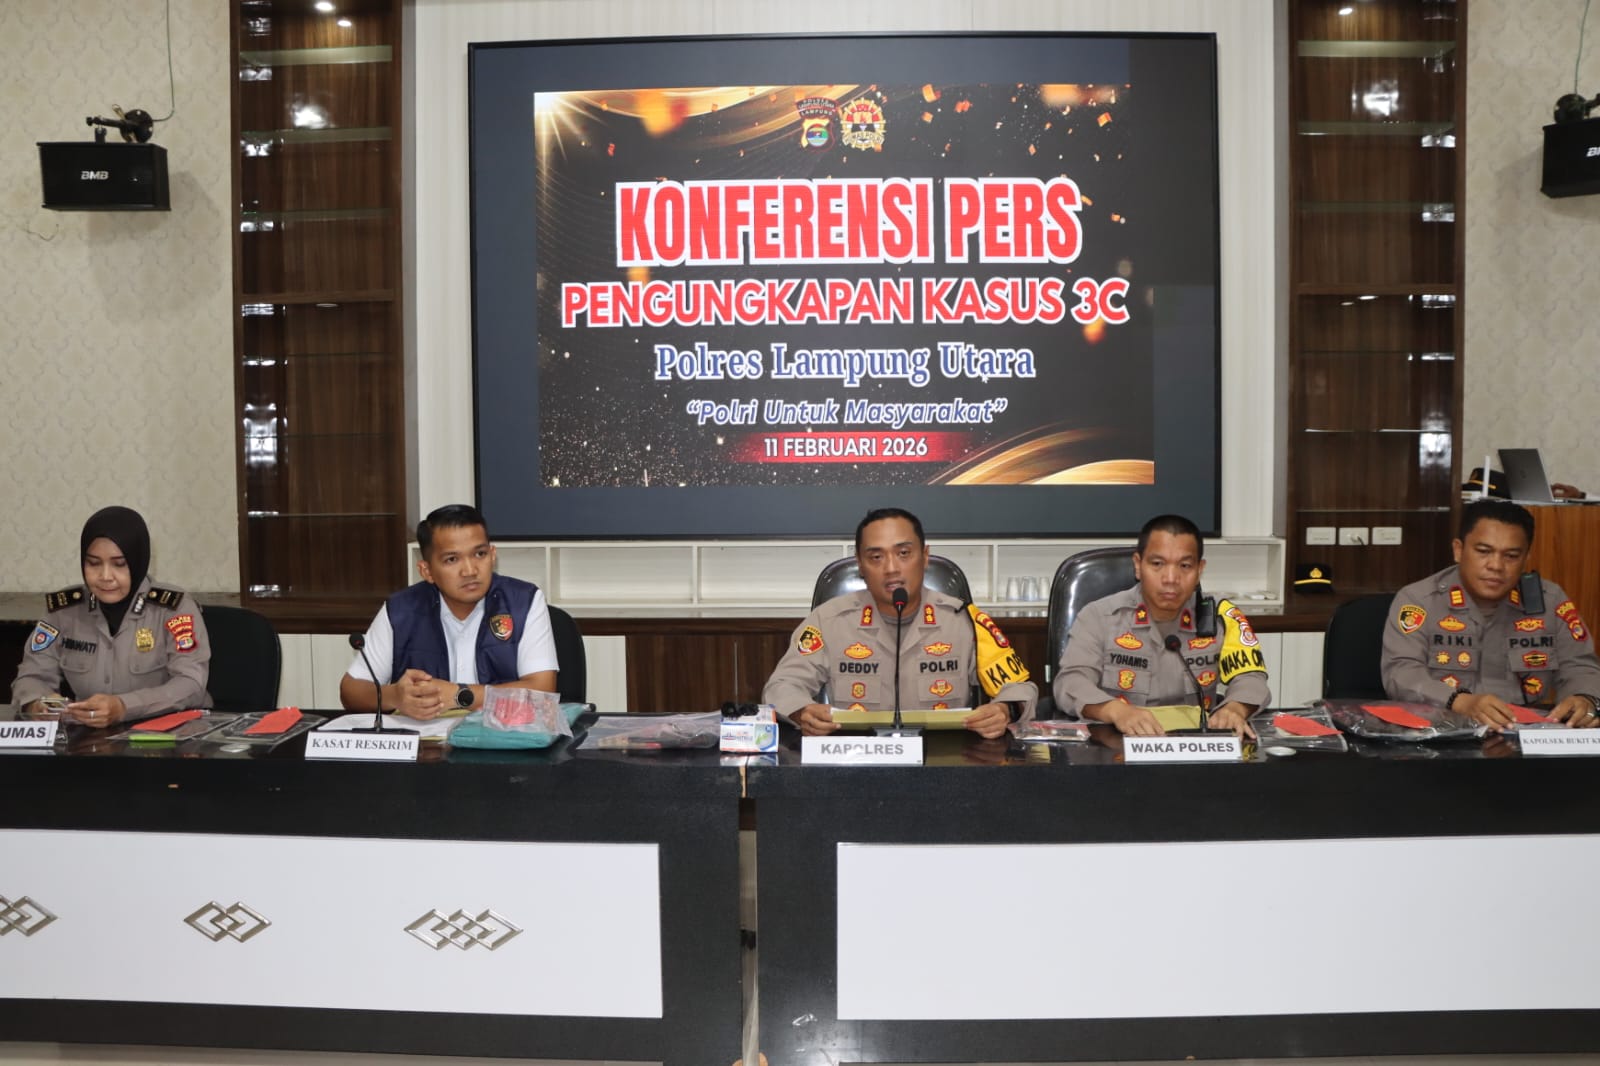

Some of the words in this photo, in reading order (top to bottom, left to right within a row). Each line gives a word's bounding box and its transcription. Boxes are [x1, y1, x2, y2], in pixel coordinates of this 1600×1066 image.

[81, 171, 109, 180] BMB
[616, 177, 934, 267] KONFERENSI
[944, 177, 1083, 264] PERS
[562, 278, 914, 328] PENGUNGKAPAN
[922, 277, 1065, 324] KASUS
[1071, 277, 1130, 324] 3C
[654, 342, 763, 380] Polres
[771, 343, 930, 387] Lampung
[937, 342, 1036, 377] Utara
[687, 399, 759, 425] “Polri
[764, 398, 840, 424] Untuk
[844, 398, 1008, 429] Masyarakat”
[764, 438, 778, 457] 11
[783, 438, 876, 457] FEBRUARI
[882, 437, 928, 456] 2026
[1433, 634, 1473, 647] RIKI
[1509, 636, 1553, 648] POLRI
[839, 662, 880, 674] DEDDY
[920, 660, 958, 673] POLRI
[1221, 649, 1251, 676] WAKA
[986, 663, 1011, 689] KA
[312, 738, 353, 749] KASAT
[355, 739, 413, 751] RESKRIM
[1131, 743, 1175, 753] WAKA
[1178, 742, 1234, 753] POLRES
